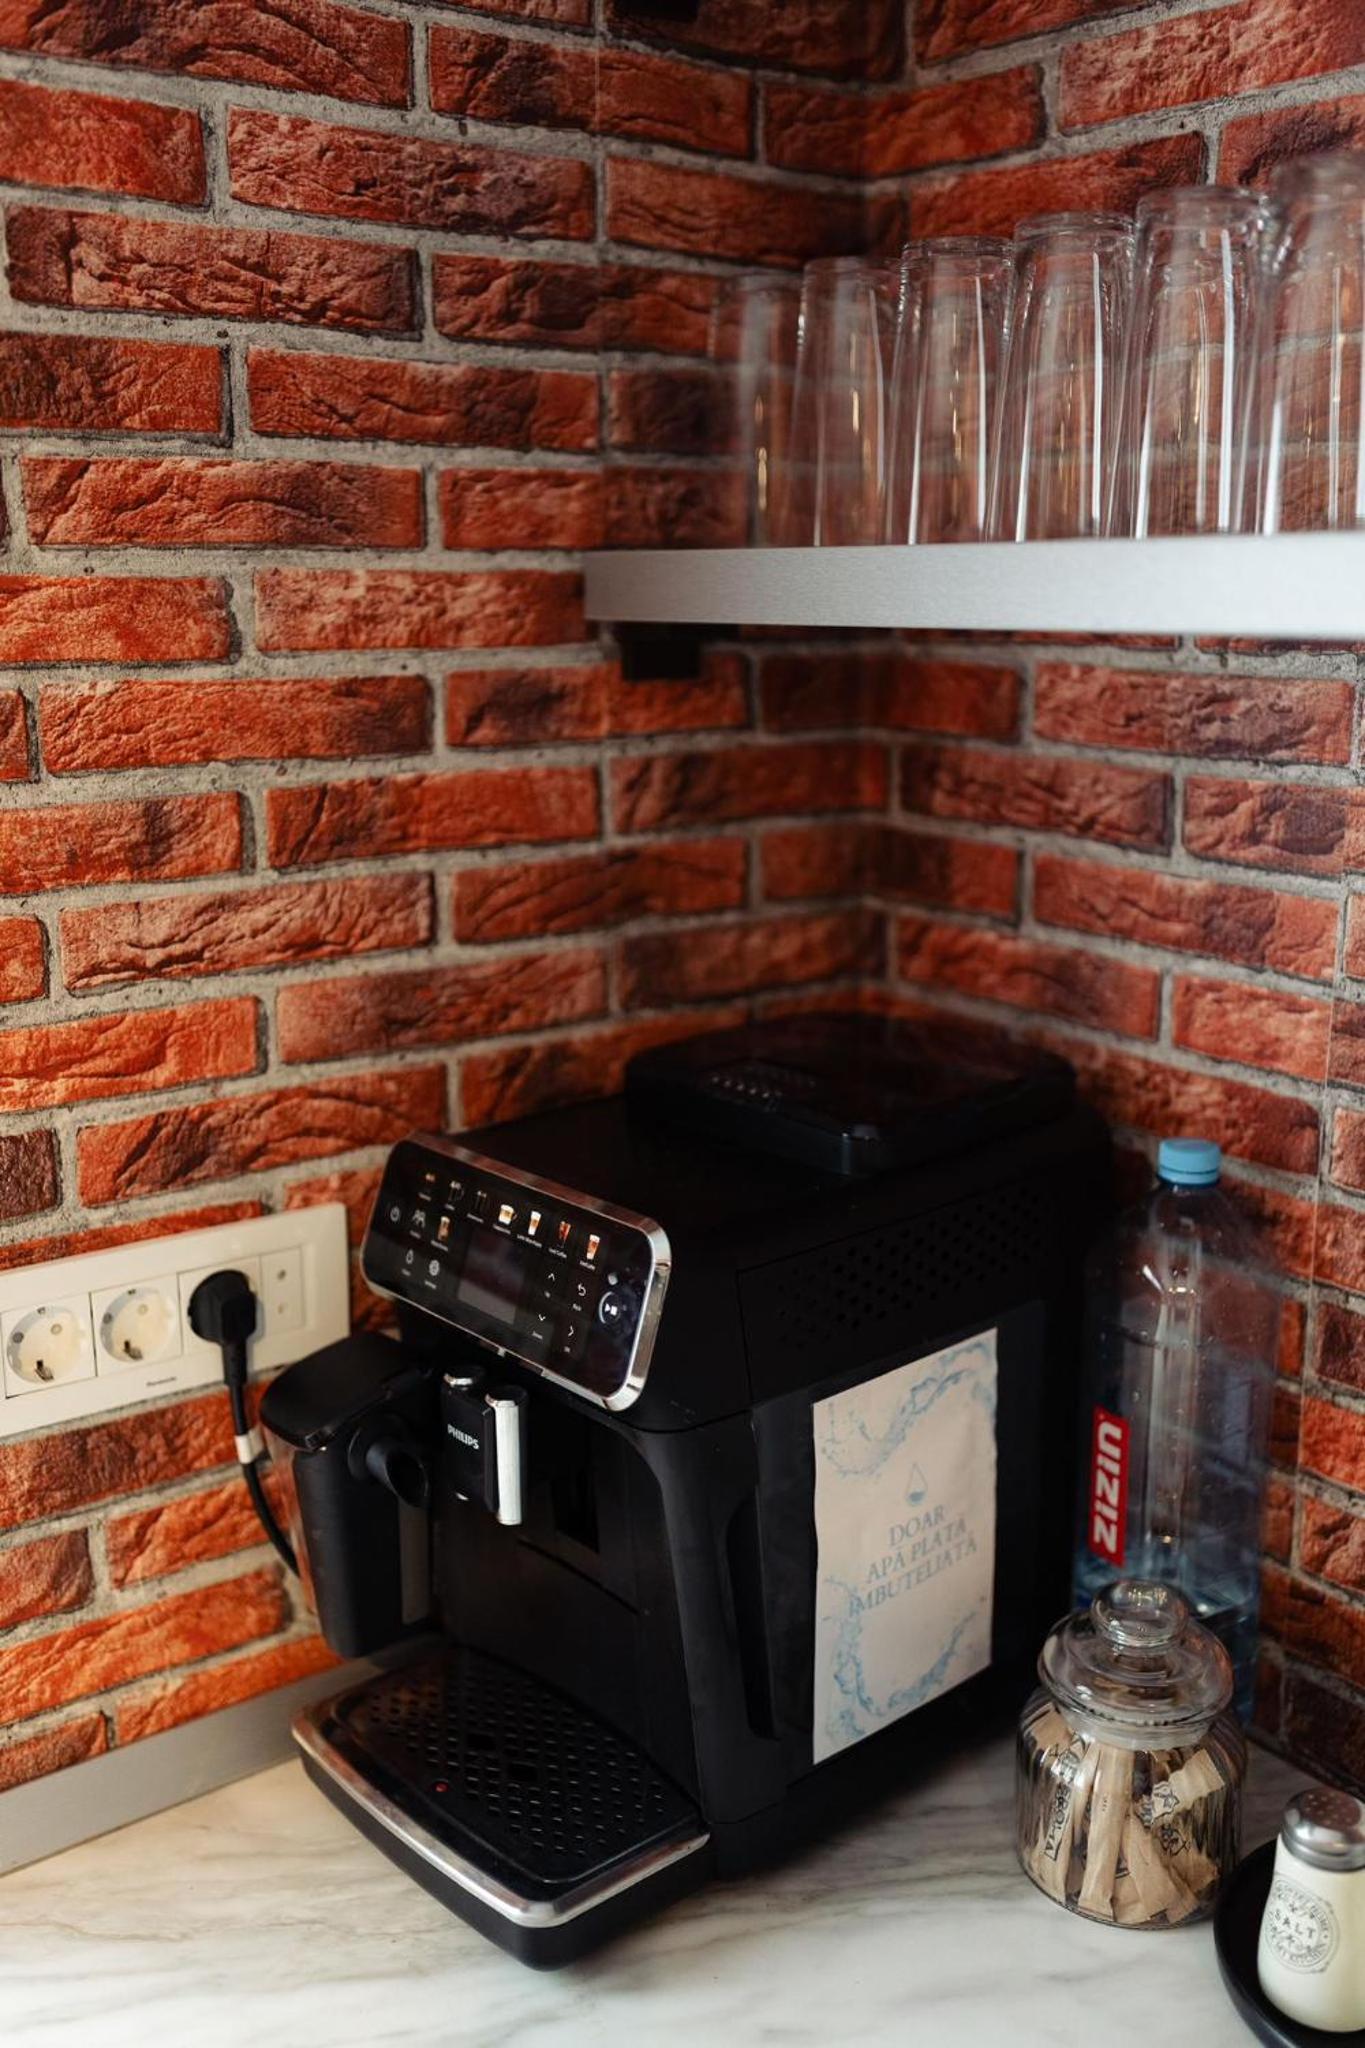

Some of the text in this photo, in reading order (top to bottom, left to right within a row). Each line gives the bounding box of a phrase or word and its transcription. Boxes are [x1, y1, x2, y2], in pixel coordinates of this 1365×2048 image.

[447, 1423, 480, 1450] PHILIPS
[888, 1503, 946, 1548] DOAR
[1274, 1908, 1316, 1939] SALT
